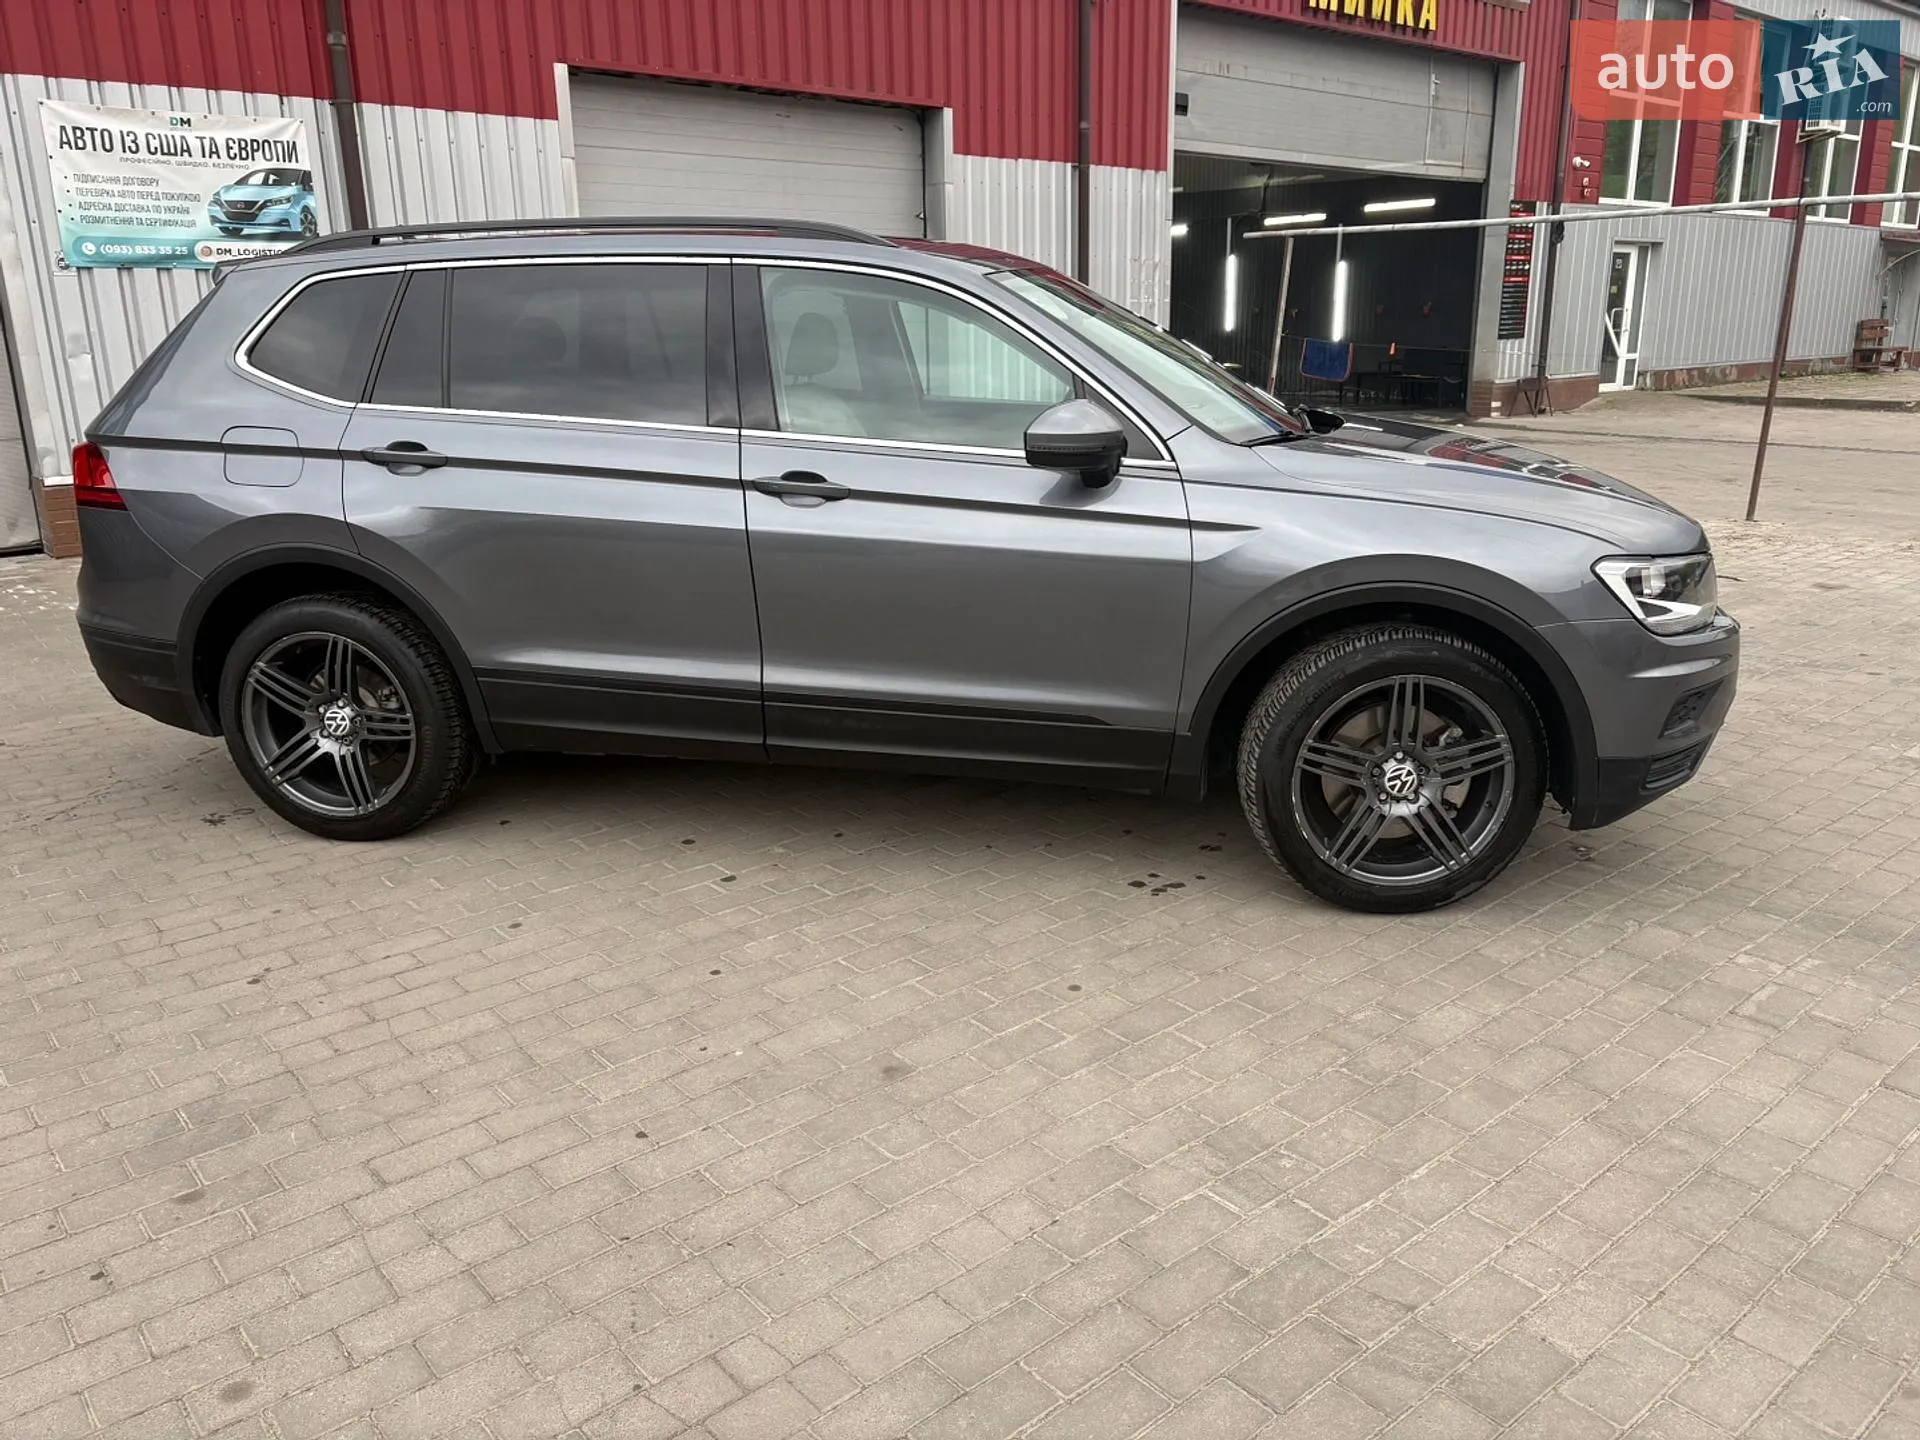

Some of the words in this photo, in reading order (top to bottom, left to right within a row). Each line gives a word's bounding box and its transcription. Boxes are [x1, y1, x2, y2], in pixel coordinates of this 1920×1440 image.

[169, 116, 192, 128] DM
[58, 125, 115, 154] АВТО
[119, 129, 140, 155] ІЗ
[144, 132, 193, 158] США
[194, 135, 222, 159] ТА
[225, 138, 299, 164] ЄВРОПИ
